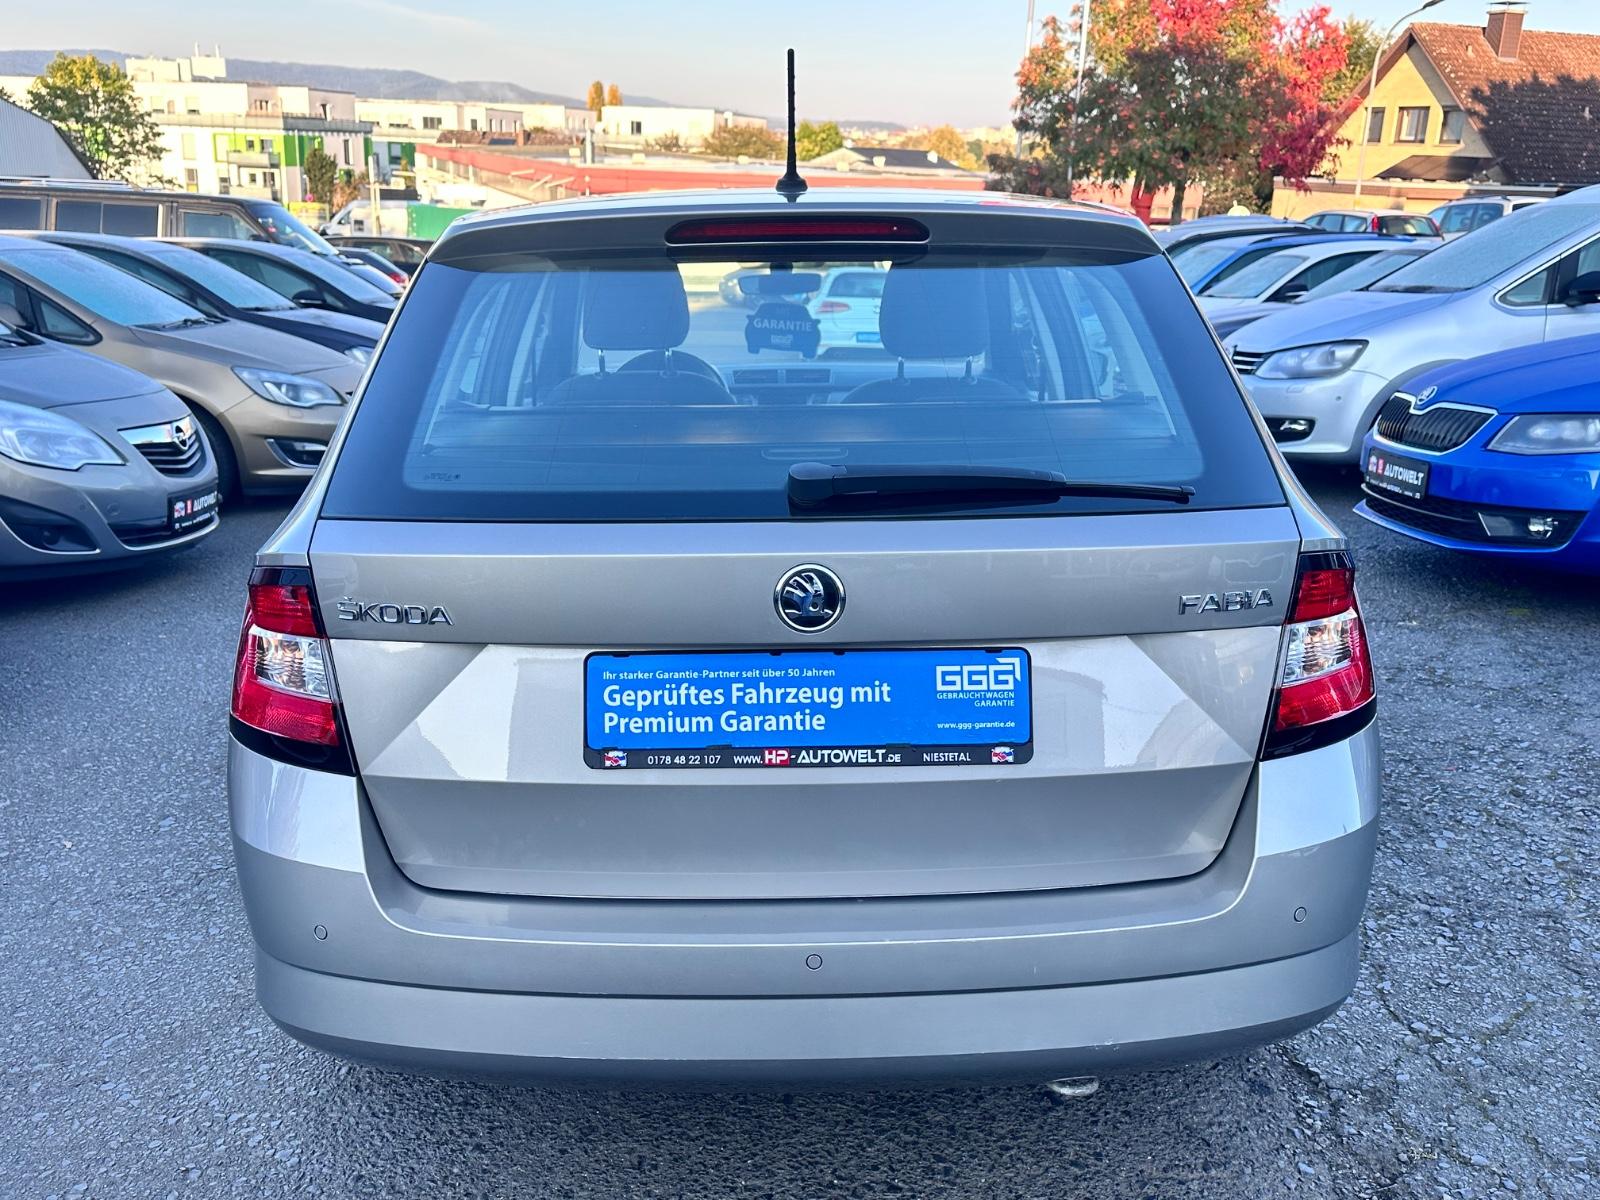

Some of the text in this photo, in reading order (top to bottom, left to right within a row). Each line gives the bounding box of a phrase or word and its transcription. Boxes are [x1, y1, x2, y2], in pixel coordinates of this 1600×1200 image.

[753, 318, 812, 331] GARANTIE
[1384, 463, 1424, 486] AUTOWELT
[336, 596, 454, 626] ŠKODA
[1178, 588, 1273, 615] FABIA
[603, 668, 835, 680] Ihr starker Garantie-Partner seit über 50 Jahren
[936, 665, 1014, 691] GGG
[603, 680, 891, 711] Geprüftes Fahrzeug mit
[604, 709, 826, 734] Premium Garantie
[937, 721, 1016, 730] www.ggg-garantie.de
[647, 755, 671, 765] 0178
[673, 755, 686, 765] 48
[688, 755, 700, 765] 22
[704, 755, 721, 765] 107
[923, 752, 972, 762] NIESTETAL
